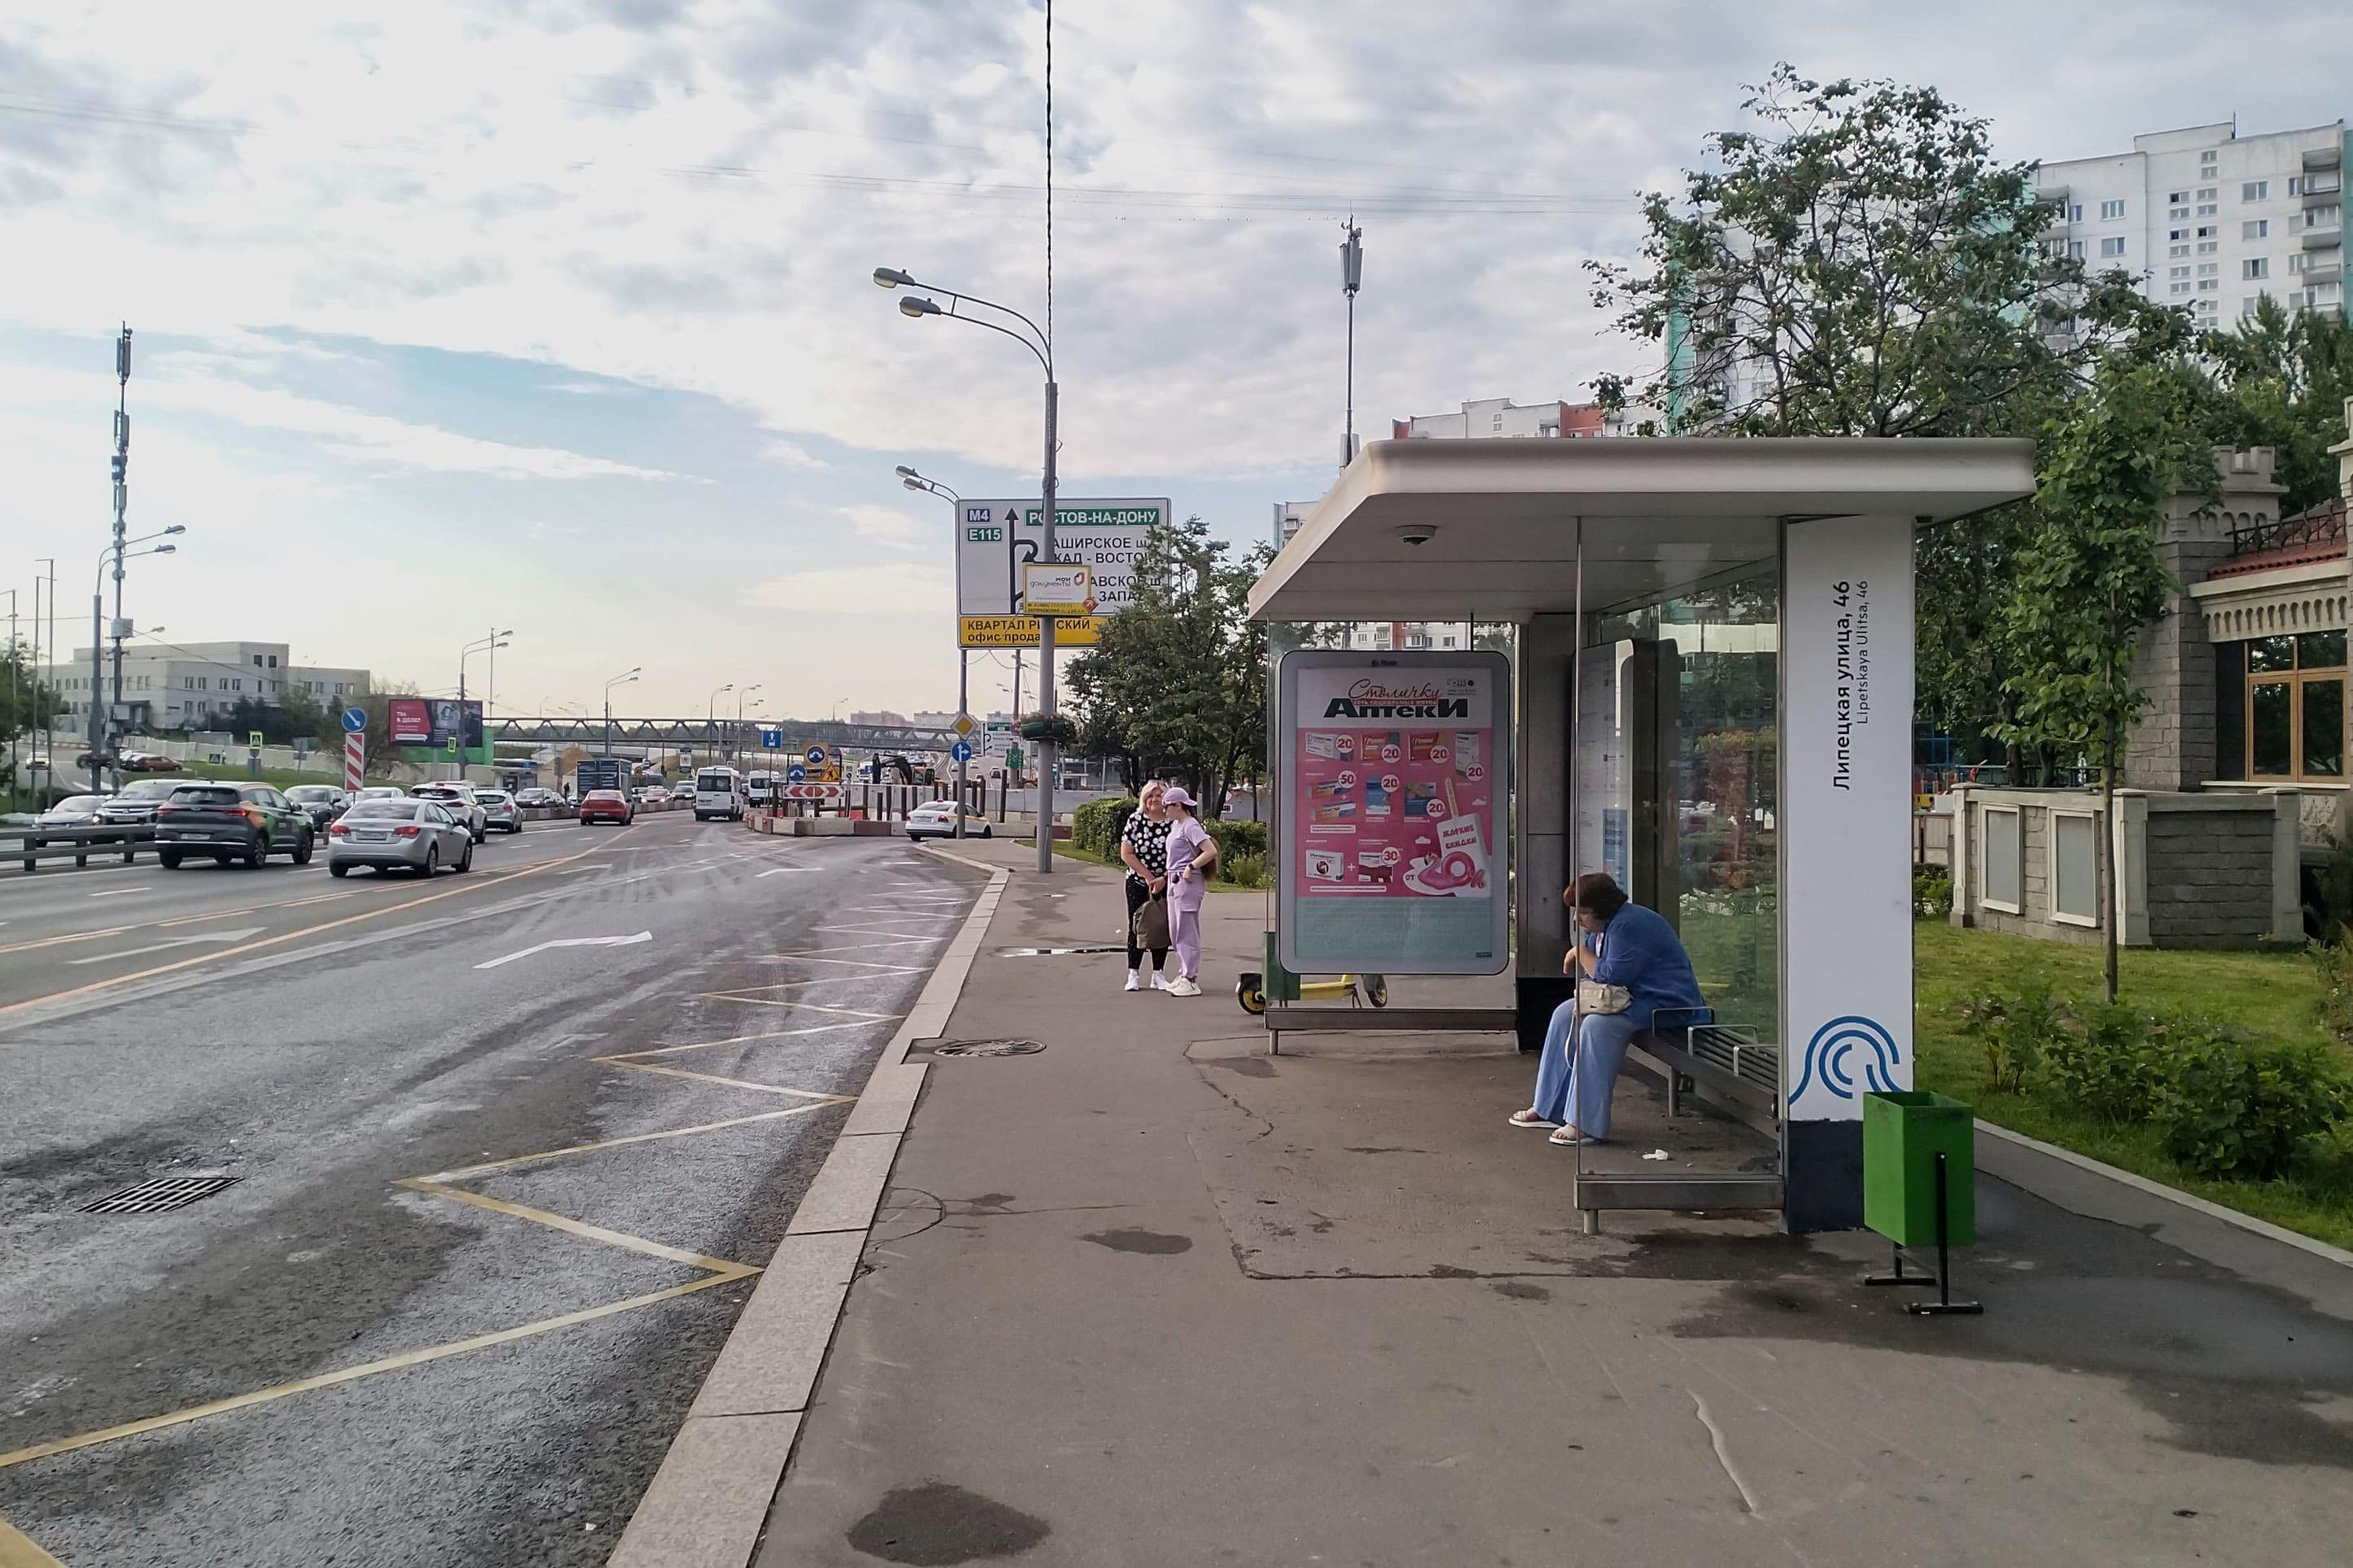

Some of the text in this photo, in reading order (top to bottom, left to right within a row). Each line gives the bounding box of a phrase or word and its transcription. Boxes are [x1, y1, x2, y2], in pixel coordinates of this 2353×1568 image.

[969, 509, 989, 522] М4
[1029, 511, 1157, 525] РТОВ-НА-ДОНУ
[969, 529, 1001, 540] E115
[1054, 538, 1131, 548] АШИРСКОЕ
[1054, 553, 1082, 563] КАД
[1096, 553, 1147, 563] ВОСТО
[1099, 591, 1141, 601] ЗАПА
[968, 618, 1090, 631] КВАРТАЛ РСКИЙ
[968, 631, 1040, 643] офис прода
[1856, 580, 1870, 724] Lipetskaya Ulitsa, 46
[1833, 580, 1853, 790] Липецкая улица, 46
